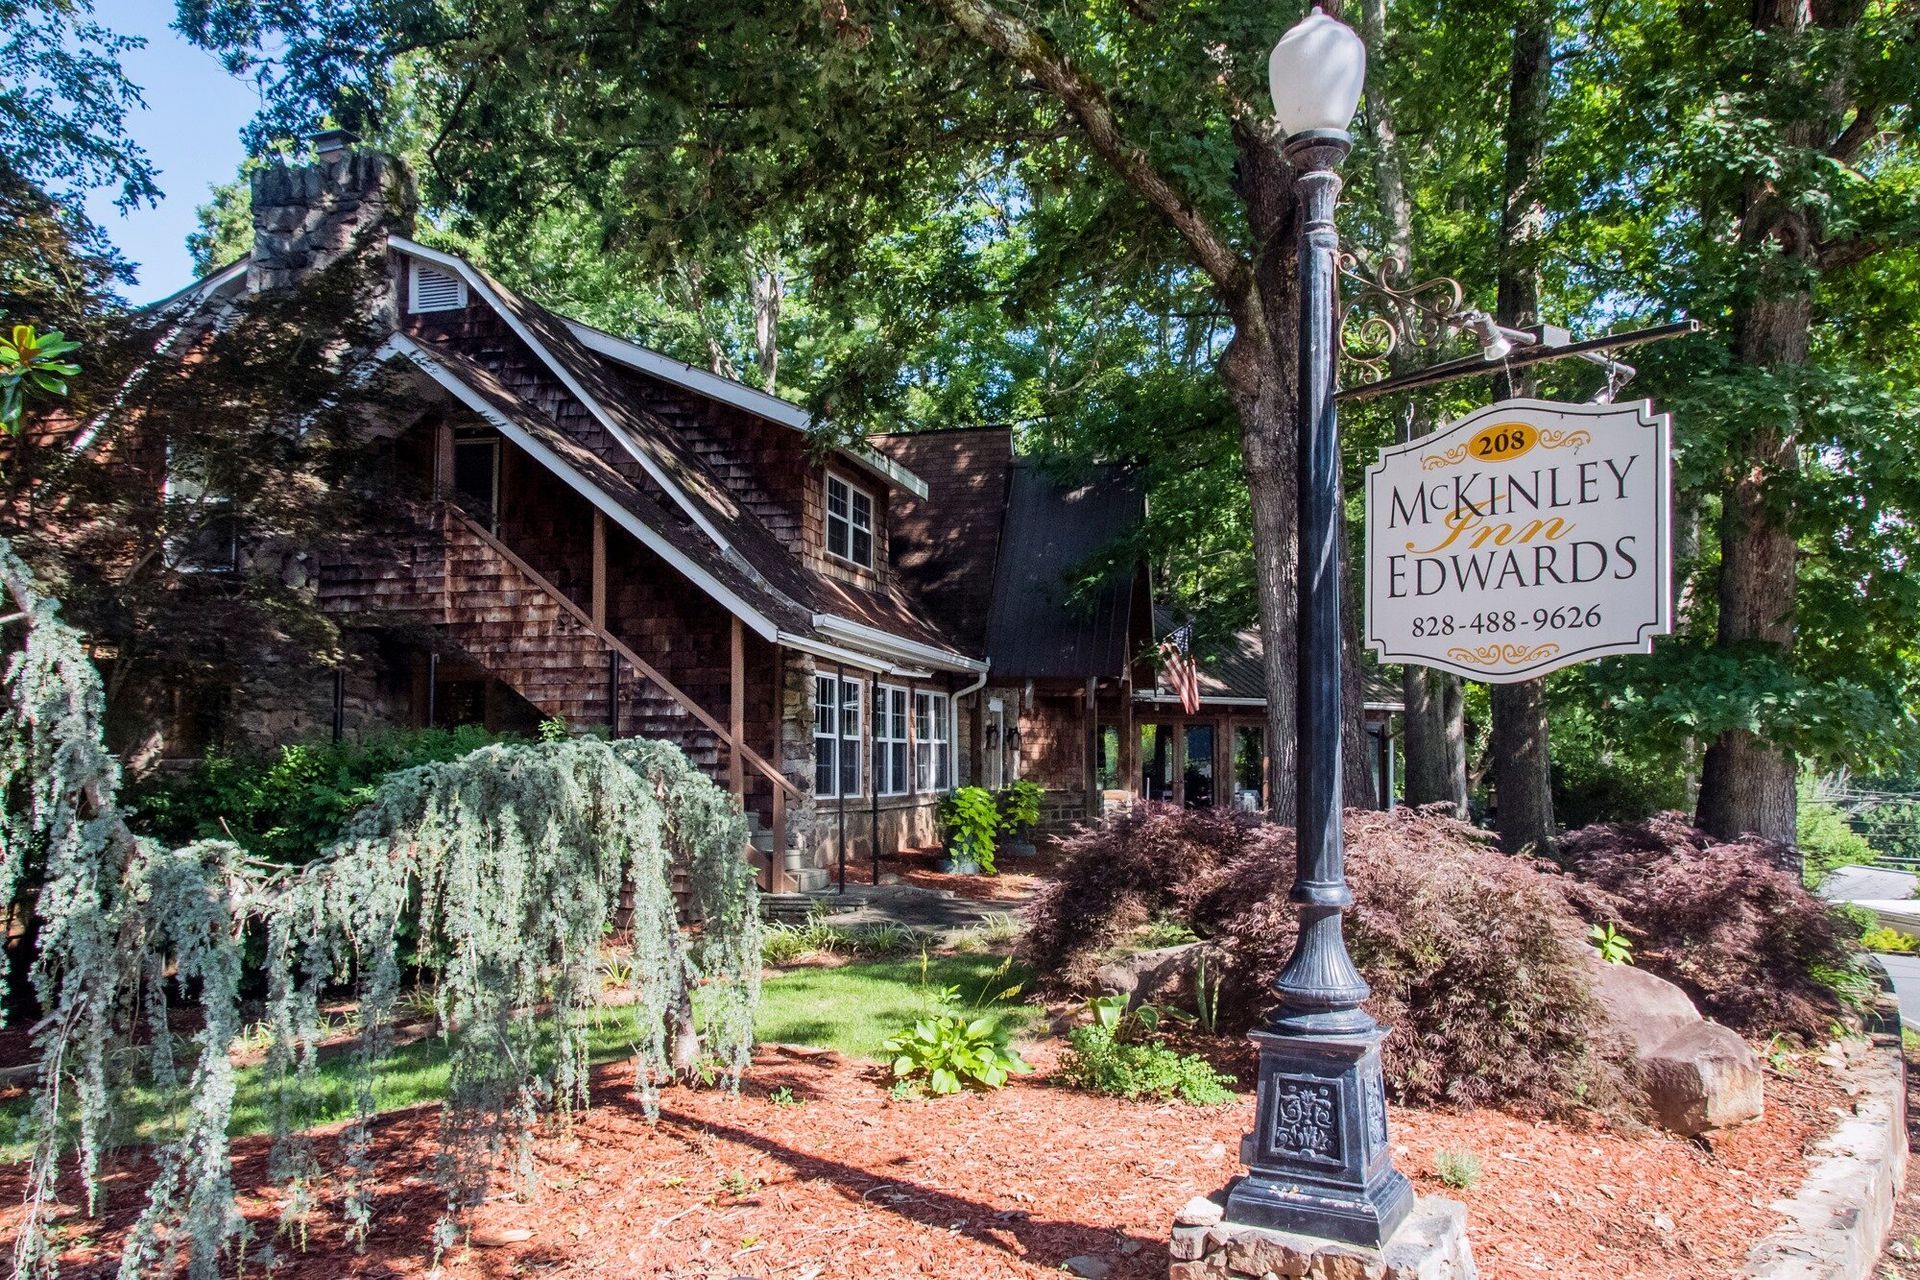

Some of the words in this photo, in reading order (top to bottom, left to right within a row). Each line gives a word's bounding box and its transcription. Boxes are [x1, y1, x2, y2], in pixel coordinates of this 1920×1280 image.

[1478, 430, 1525, 455] 208
[1405, 494, 1576, 554] Inn
[1387, 536, 1637, 598] EDWARDS
[1412, 604, 1601, 637] 828-488-9626
